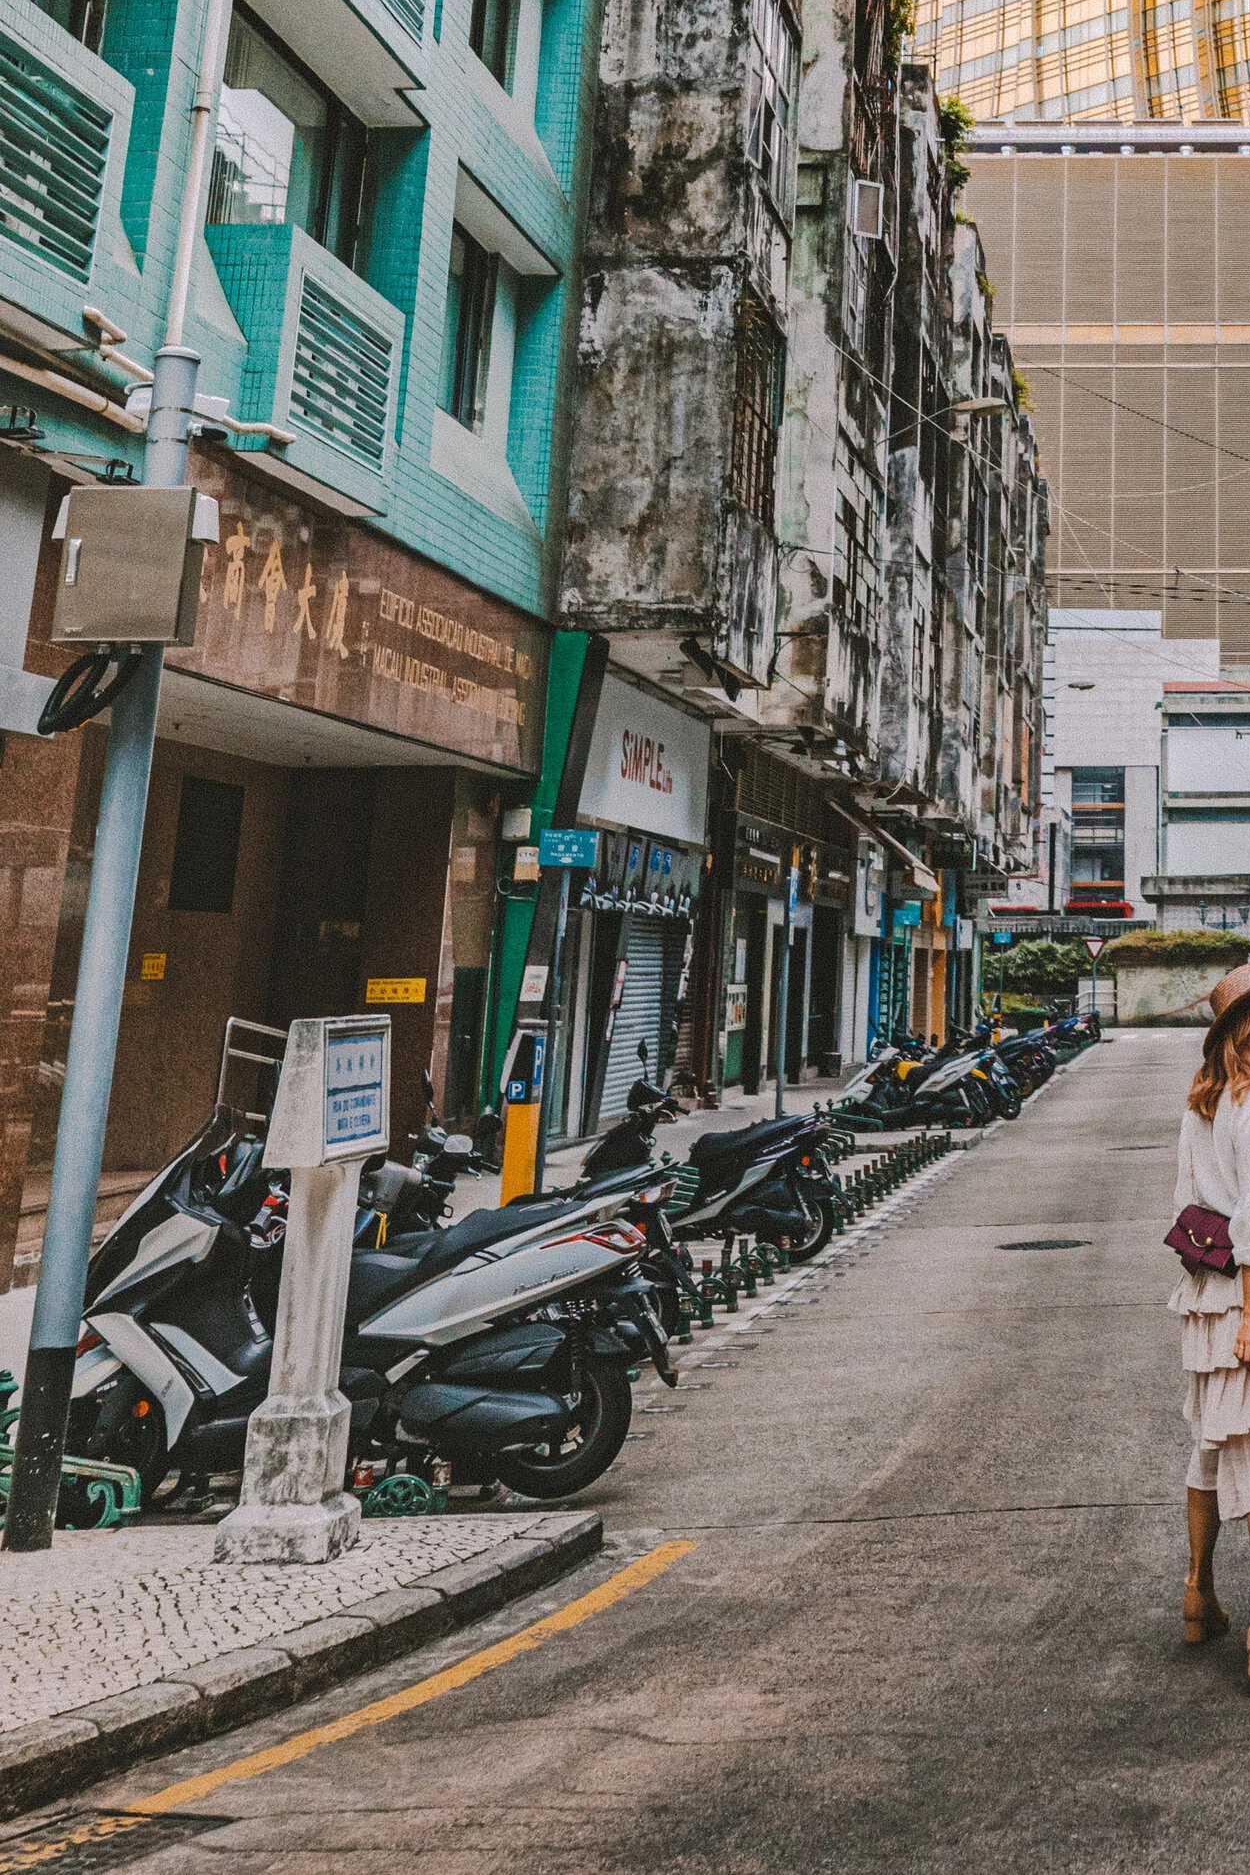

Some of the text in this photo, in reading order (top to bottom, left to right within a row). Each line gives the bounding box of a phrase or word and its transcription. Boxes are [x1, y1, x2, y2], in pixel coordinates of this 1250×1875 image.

[200, 520, 349, 659] 商會大廈
[534, 1045, 542, 1079] P
[512, 1082, 522, 1097] P
